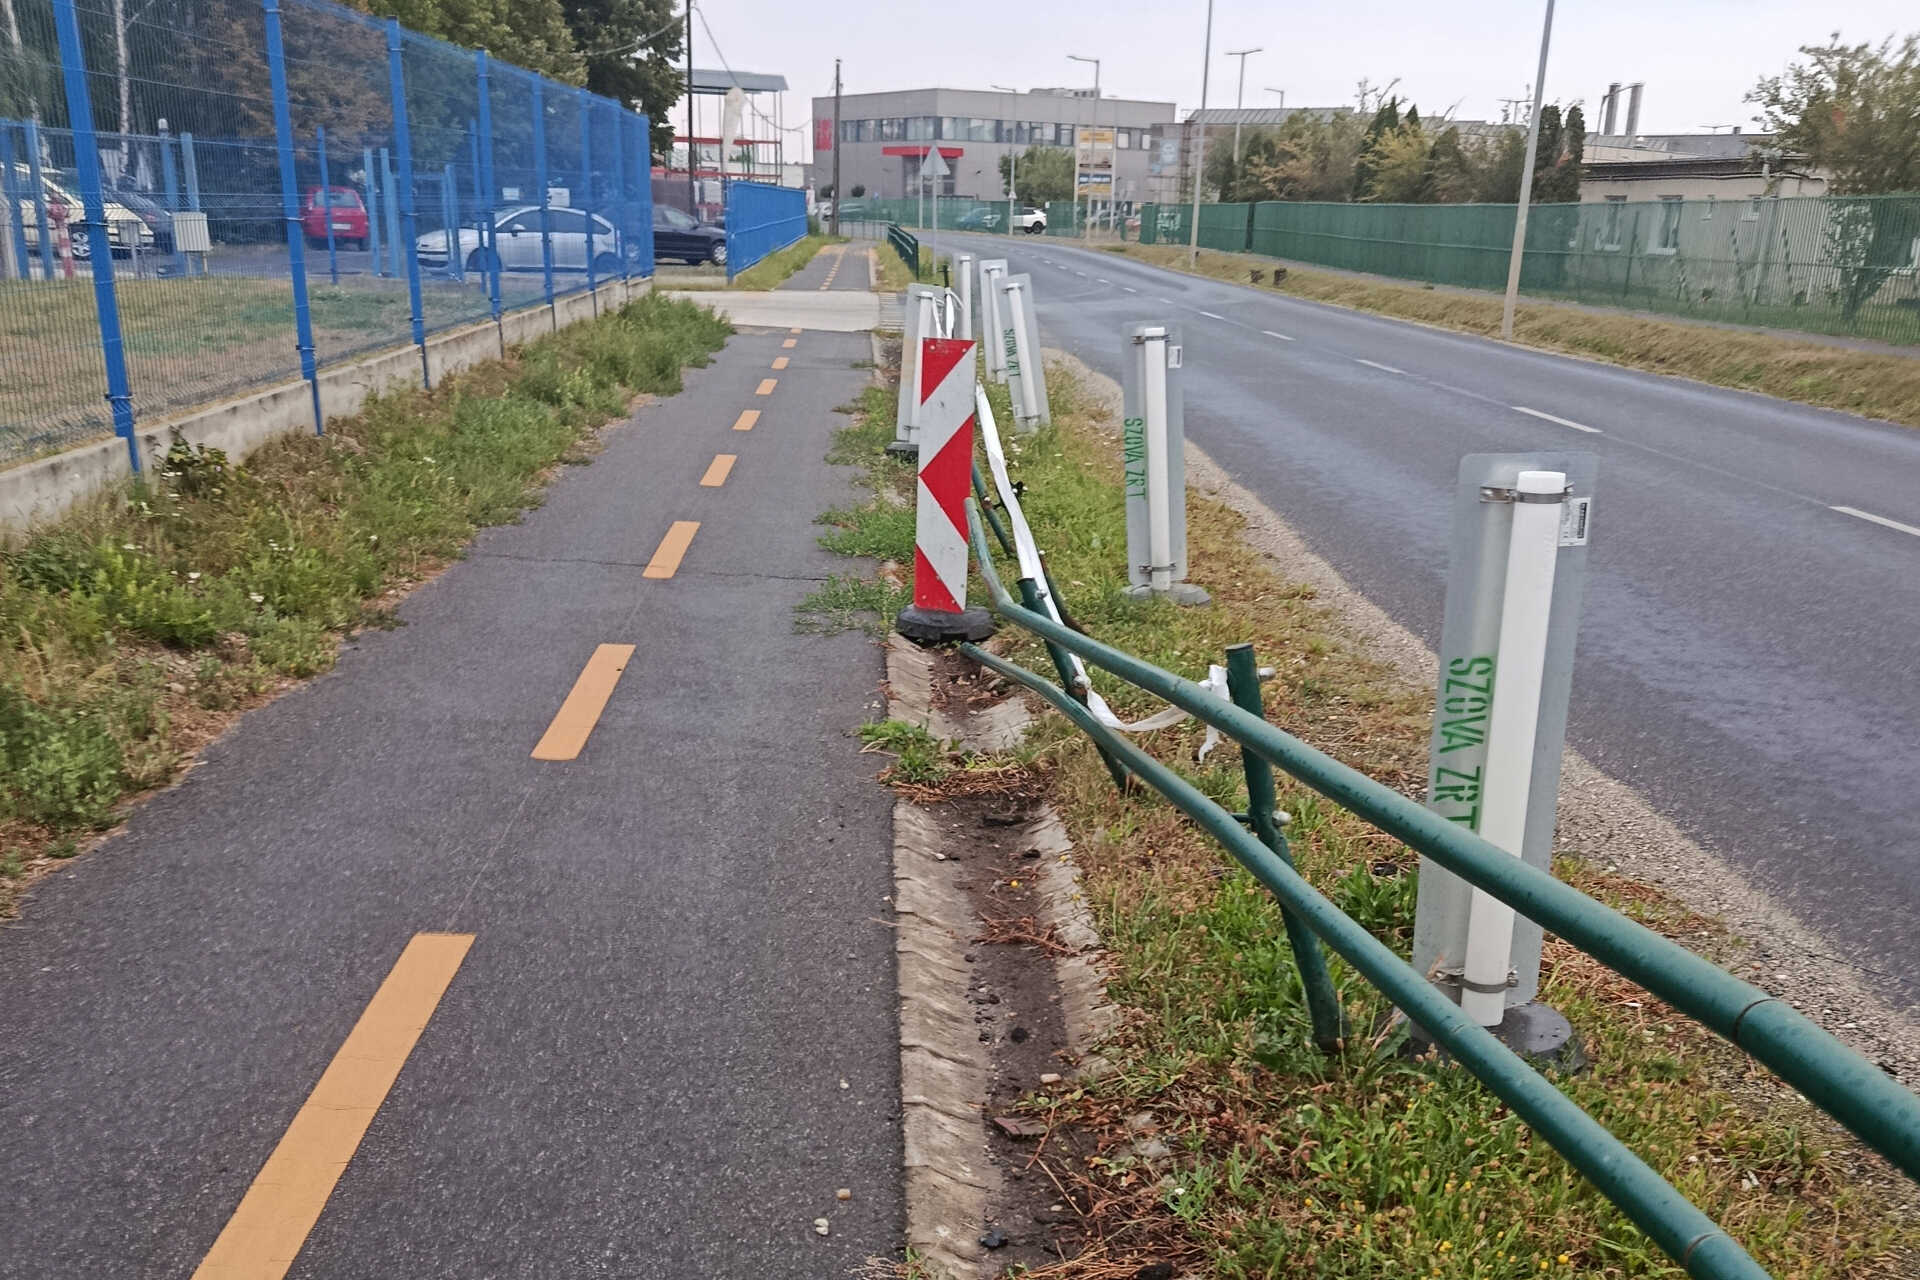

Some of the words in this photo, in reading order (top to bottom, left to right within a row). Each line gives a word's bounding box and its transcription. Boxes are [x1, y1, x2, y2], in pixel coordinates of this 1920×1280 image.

[1124, 418, 1144, 464] SZOVA
[1126, 469, 1146, 500] ZRT
[1439, 656, 1493, 754] SZOVA
[1433, 766, 1481, 830] ZRT
